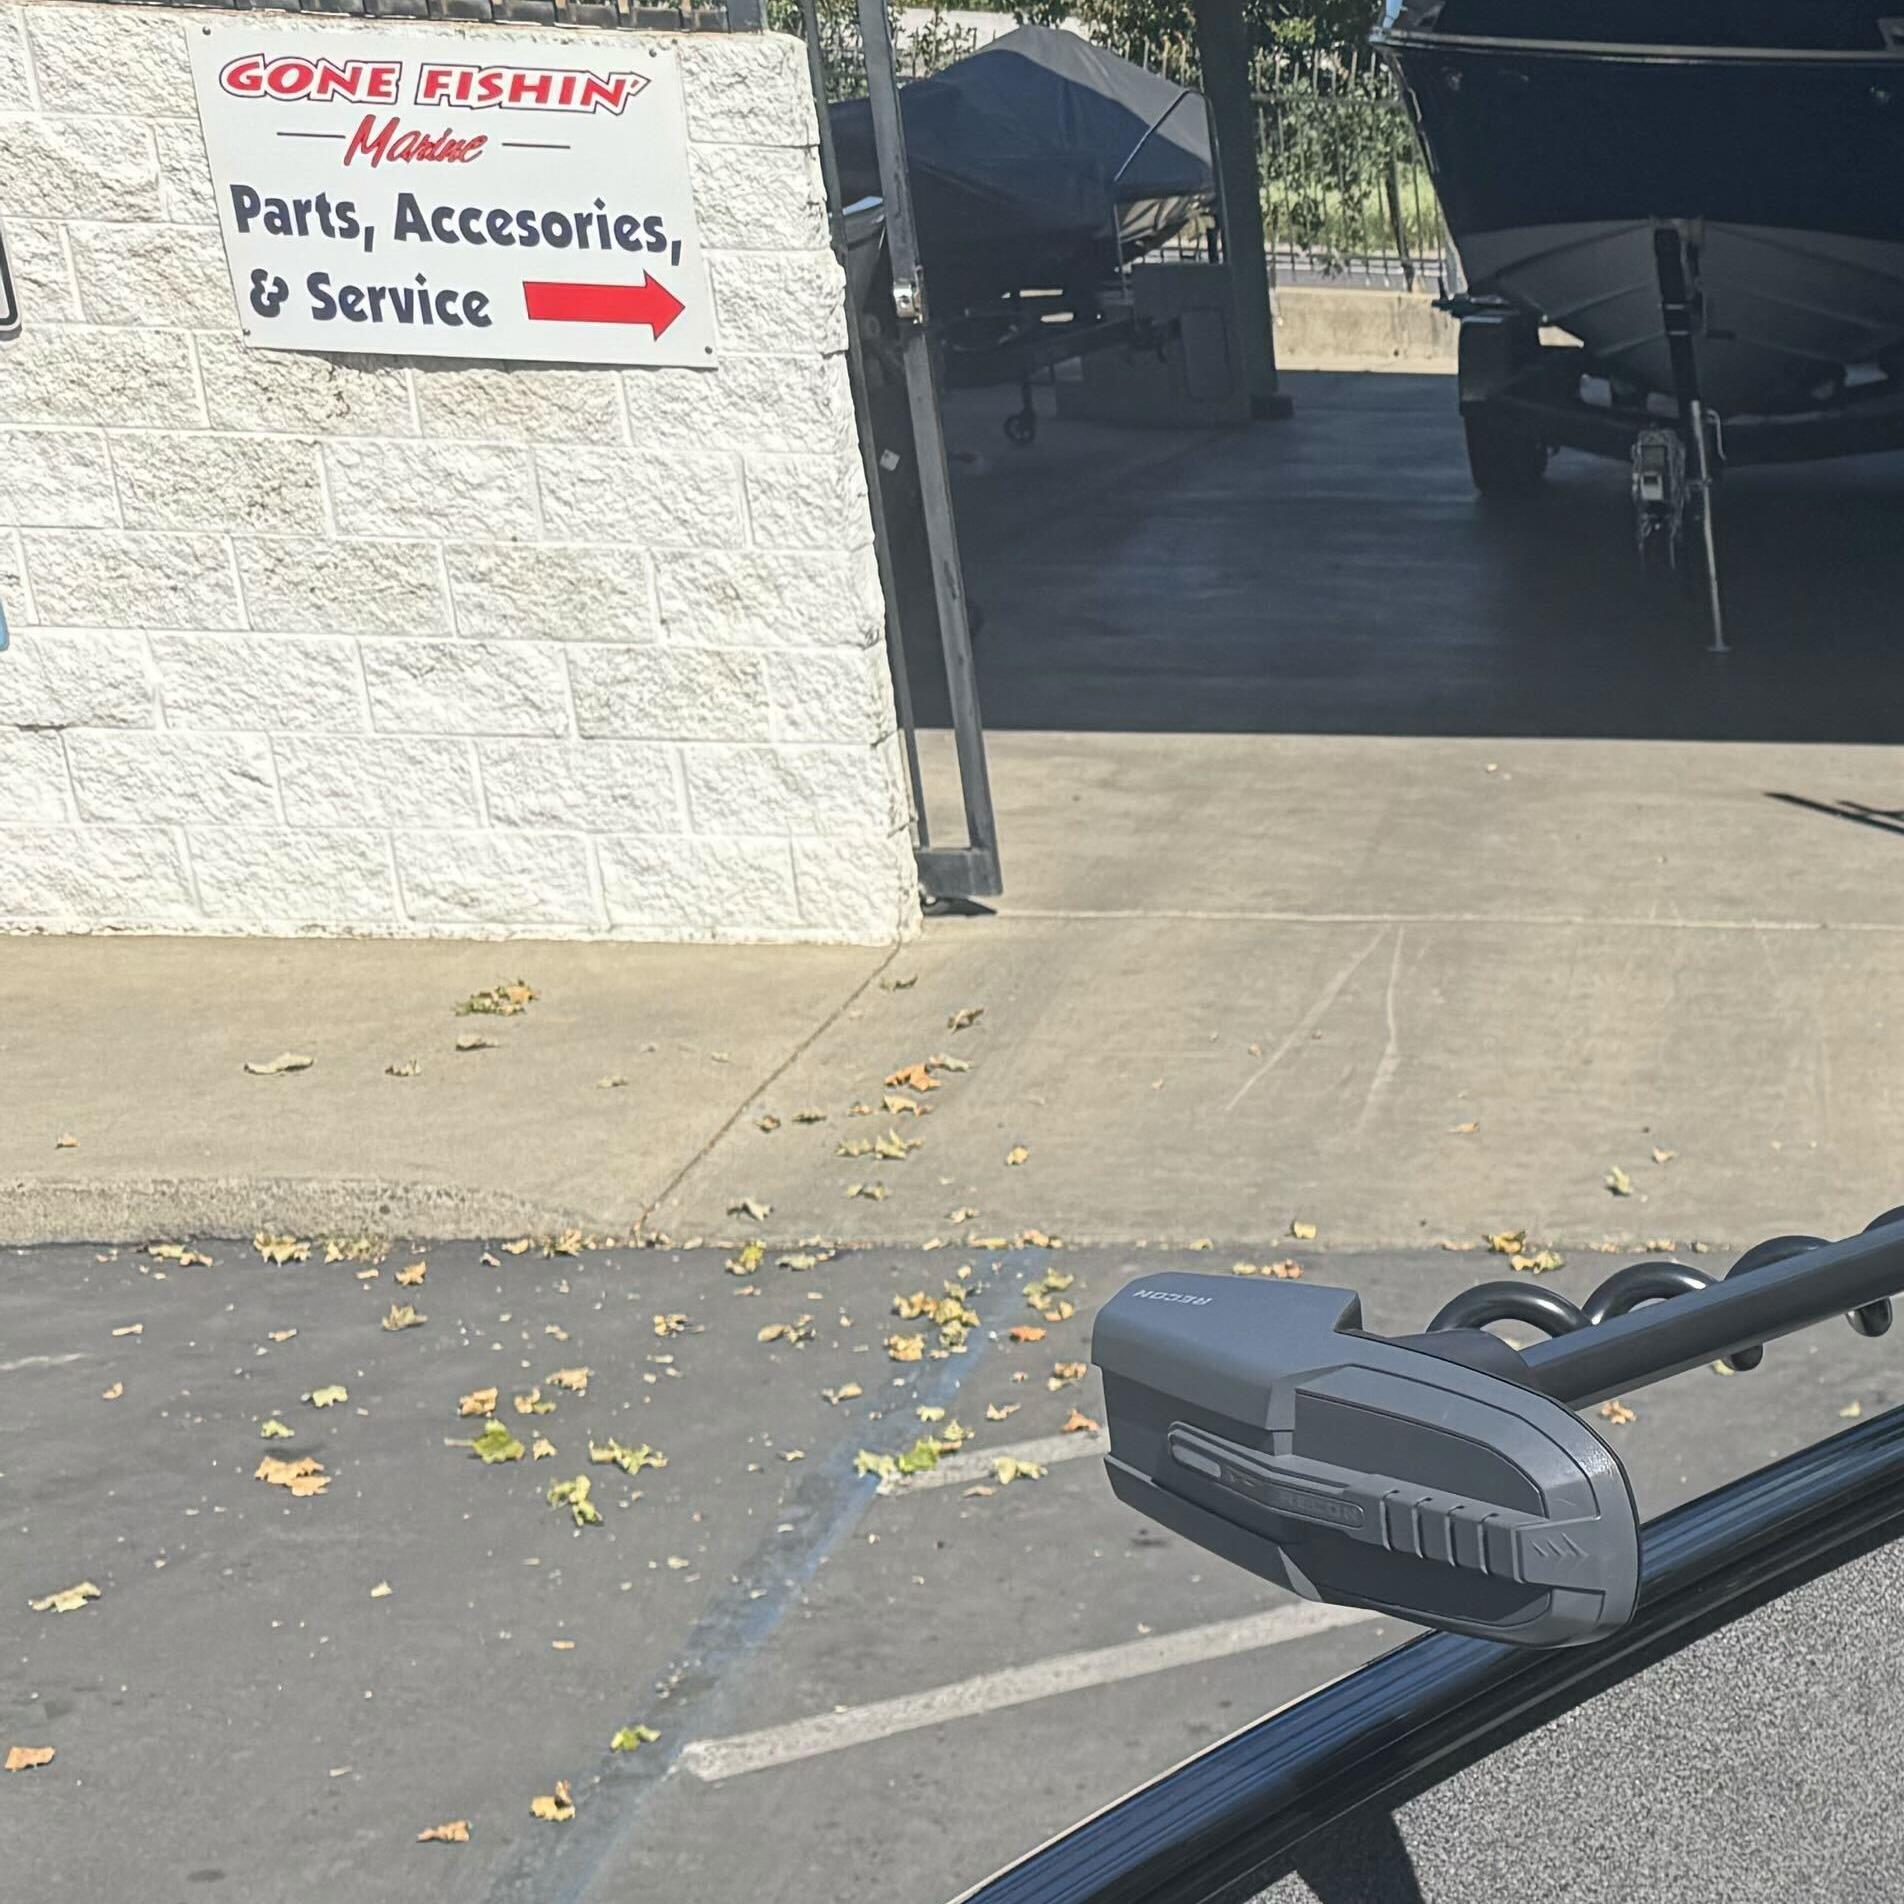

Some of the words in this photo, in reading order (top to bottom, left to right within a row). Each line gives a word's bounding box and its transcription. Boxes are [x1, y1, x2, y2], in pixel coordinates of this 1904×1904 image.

[221, 55, 401, 103] GONE
[415, 62, 651, 114] FISHIN'
[343, 115, 488, 167] Marine
[229, 184, 375, 252] Parts,
[394, 192, 682, 266] Accesories,
[249, 268, 289, 318] &
[306, 271, 493, 328] Service
